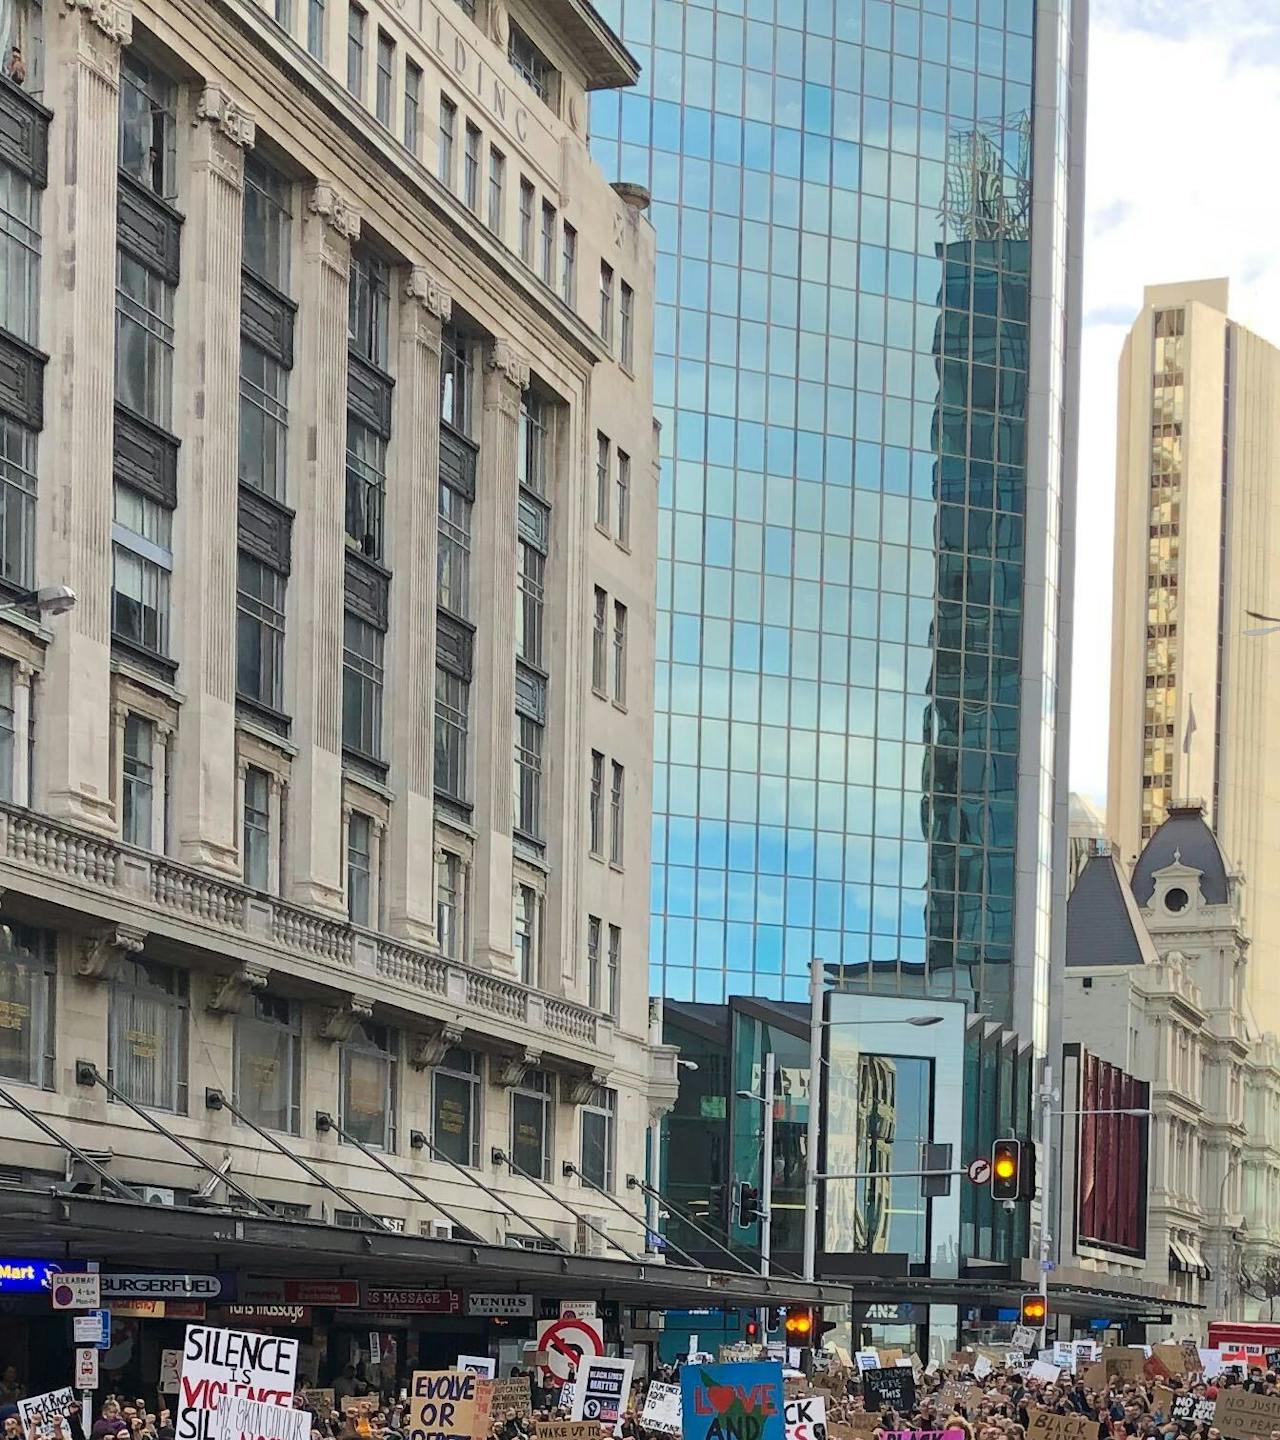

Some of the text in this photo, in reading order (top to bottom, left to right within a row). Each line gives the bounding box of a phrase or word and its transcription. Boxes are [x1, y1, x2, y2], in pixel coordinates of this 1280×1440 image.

[101, 1278, 215, 1293] BURGERFUEL
[383, 1293, 440, 1304] MASSAGE
[866, 1304, 898, 1318] ANZ
[186, 1329, 294, 1375] SILENCE
[229, 1368, 251, 1384] IS
[866, 1371, 882, 1382] NO
[415, 1375, 476, 1401] EVOLVE
[589, 1381, 619, 1391] MATTER
[880, 1389, 901, 1398] THIS
[1176, 1397, 1193, 1408] NO
[1225, 1397, 1245, 1408] NO
[216, 1396, 232, 1429] MY
[235, 1400, 263, 1437] SKIN
[420, 1403, 456, 1427] OR
[1173, 1408, 1215, 1420] NO PEAC
[1034, 1415, 1086, 1435] BLACK
[1222, 1416, 1244, 1425] NO
[539, 1427, 567, 1438] WAKE
[570, 1427, 585, 1437] UP
